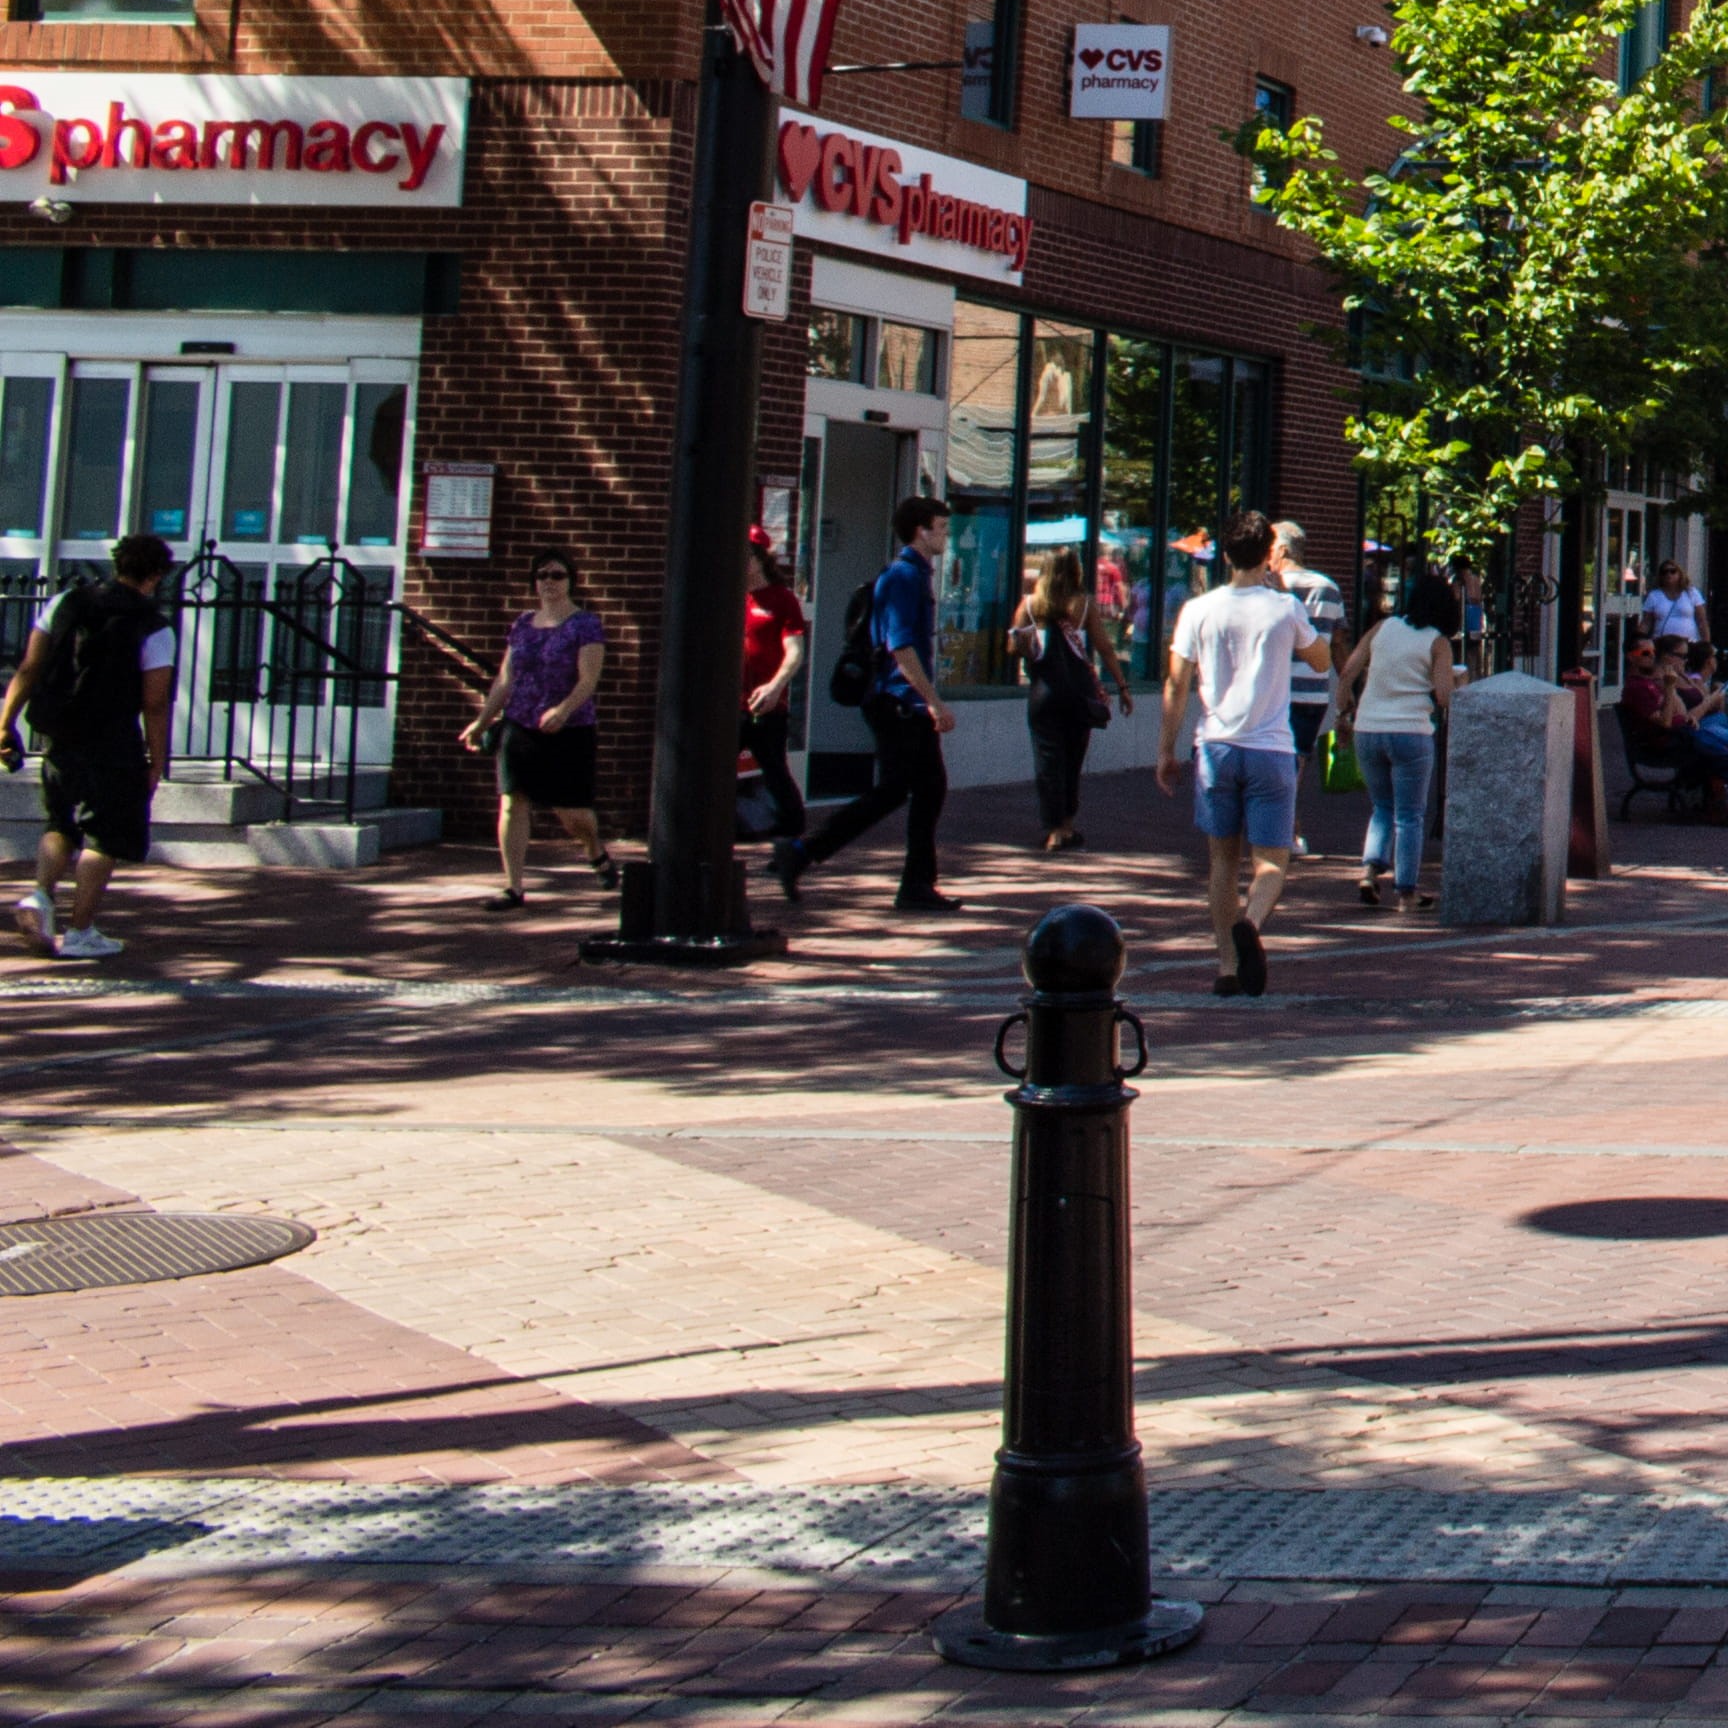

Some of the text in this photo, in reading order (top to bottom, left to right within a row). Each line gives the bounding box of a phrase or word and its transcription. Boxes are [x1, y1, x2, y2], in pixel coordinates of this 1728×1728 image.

[1105, 48, 1162, 73] CVS
[1079, 73, 1159, 94] pharmacy
[51, 100, 448, 191] pharmacy
[816, 132, 1033, 273] CVS pharmacy
[755, 245, 784, 265] POLICE
[757, 285, 778, 301] ONLY
